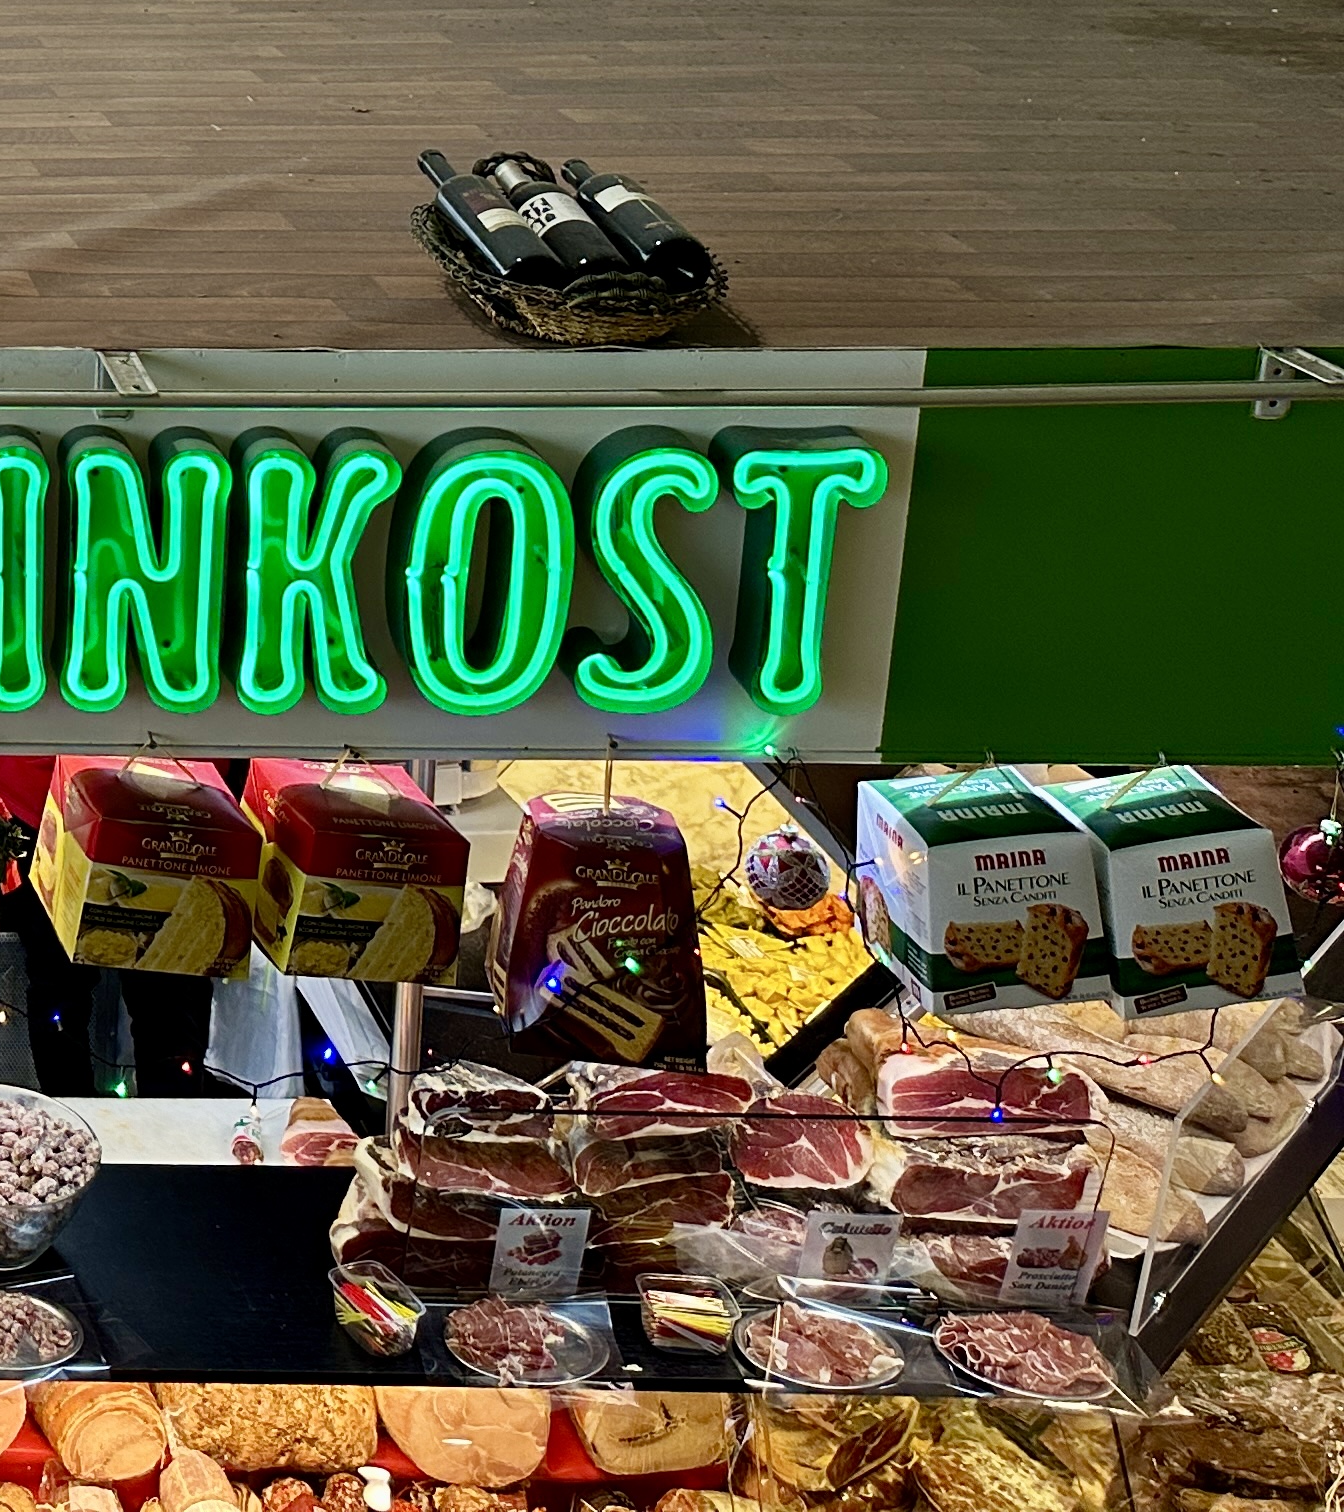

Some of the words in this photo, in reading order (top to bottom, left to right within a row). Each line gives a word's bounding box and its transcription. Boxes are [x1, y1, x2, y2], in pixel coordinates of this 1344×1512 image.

[332, 816, 394, 828] PANETTONE
[936, 802, 1029, 822] MAINA
[1115, 800, 1210, 824] MAINA
[875, 813, 904, 850] MAINA
[141, 838, 217, 857] GRANDUCALE
[355, 848, 429, 865] GRANDUCALE
[121, 855, 187, 873] PANETTONE
[190, 863, 231, 876] LIMONE
[974, 848, 1047, 872] MAINA
[1157, 847, 1231, 873] MAINA
[335, 867, 399, 882] PANETTONE
[401, 872, 442, 884] LIMONE
[575, 865, 659, 886] GRANDUCALE
[957, 881, 969, 896] IL
[972, 872, 1071, 895] PANETTONE
[1141, 885, 1154, 899] IL
[1157, 869, 1257, 897] PANETTONE
[571, 894, 621, 917] Pandoro
[973, 894, 1009, 908] SENZA
[1010, 890, 1058, 905] CANDITI
[1158, 896, 1195, 909] SENZA
[1196, 889, 1243, 904] CANDITI
[573, 904, 679, 943] Cioccolato
[508, 1213, 576, 1227] Aktion
[1029, 1215, 1097, 1229] Aktion
[1008, 1281, 1032, 1290] San
